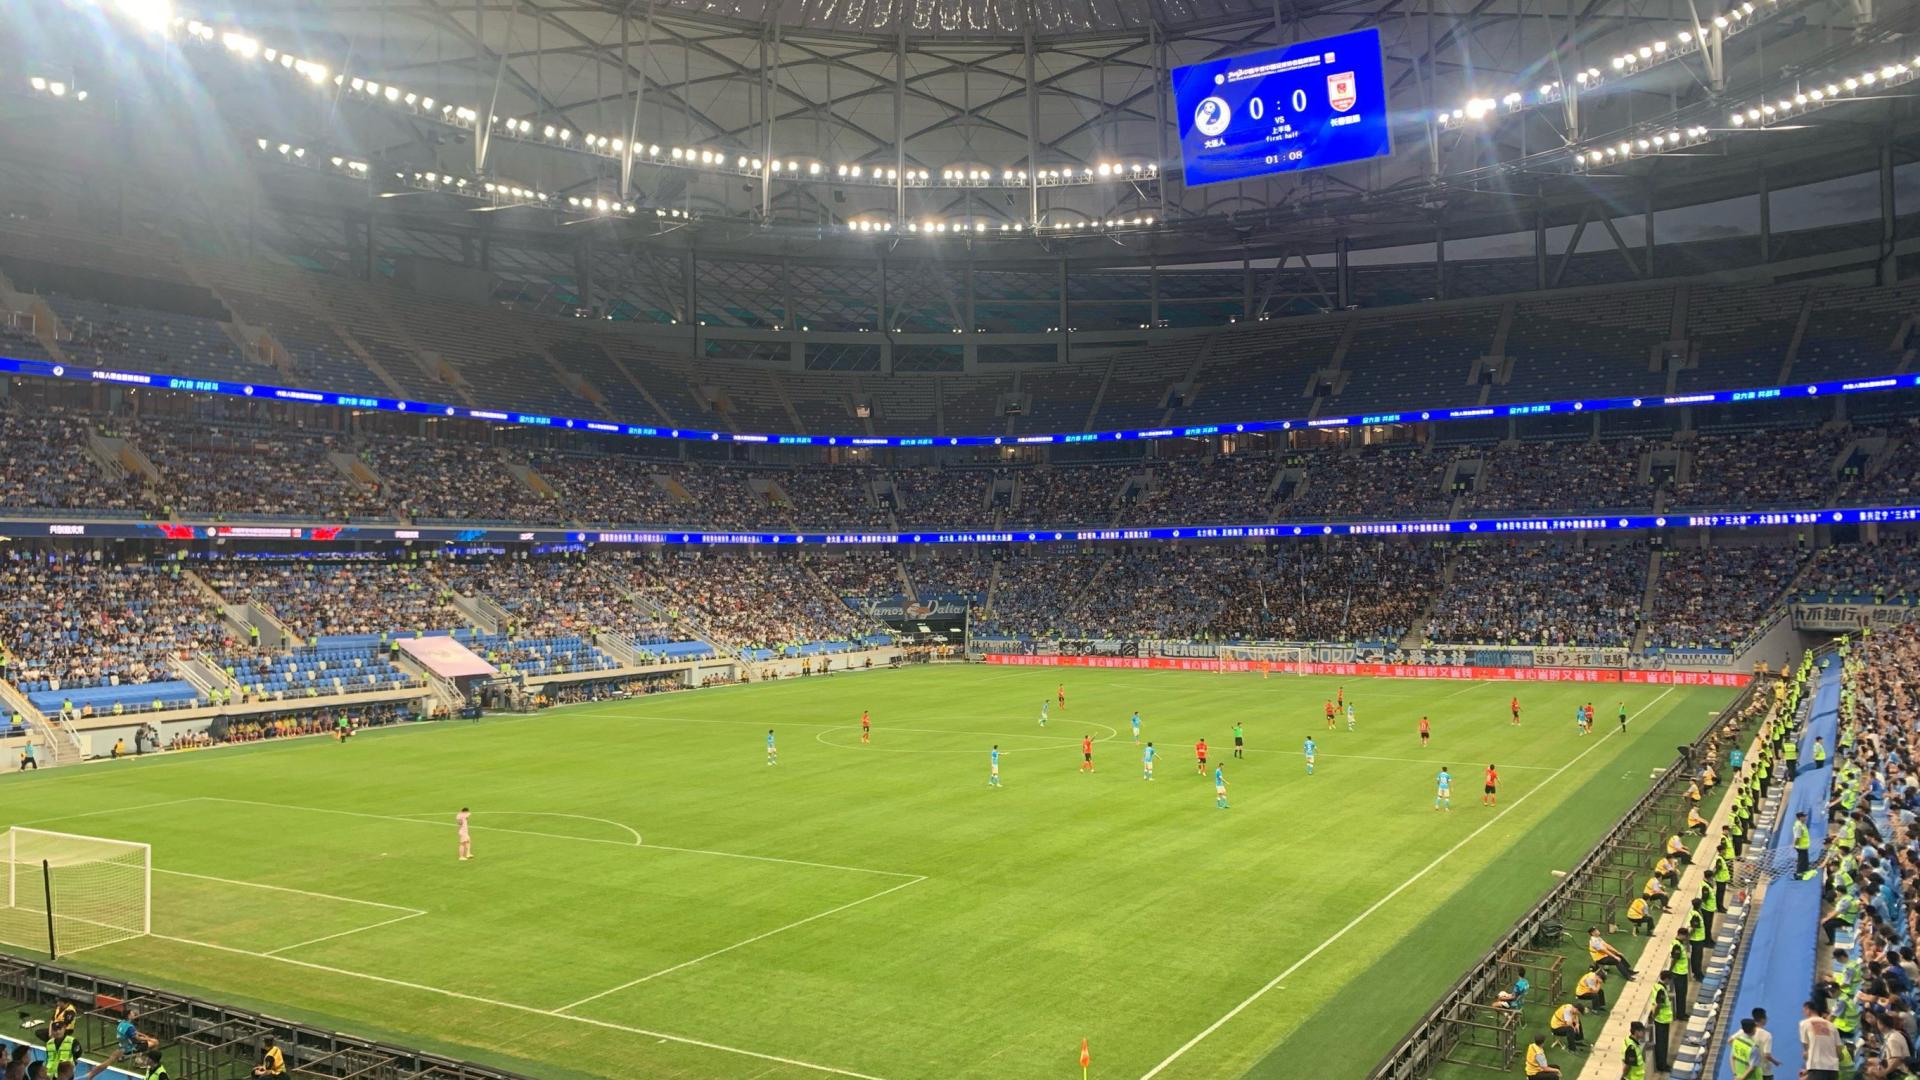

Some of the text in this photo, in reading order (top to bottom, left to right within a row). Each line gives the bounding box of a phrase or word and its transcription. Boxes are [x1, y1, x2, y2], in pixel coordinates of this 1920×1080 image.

[1249, 97, 1264, 120] 0
[1292, 89, 1307, 112] 0
[1274, 116, 1285, 124] VS
[1265, 131, 1299, 143] first half
[1204, 139, 1226, 149] 大连人
[1265, 154, 1279, 164] 01
[1288, 151, 1303, 160] 08
[864, 600, 965, 615] Vamos Dalia
